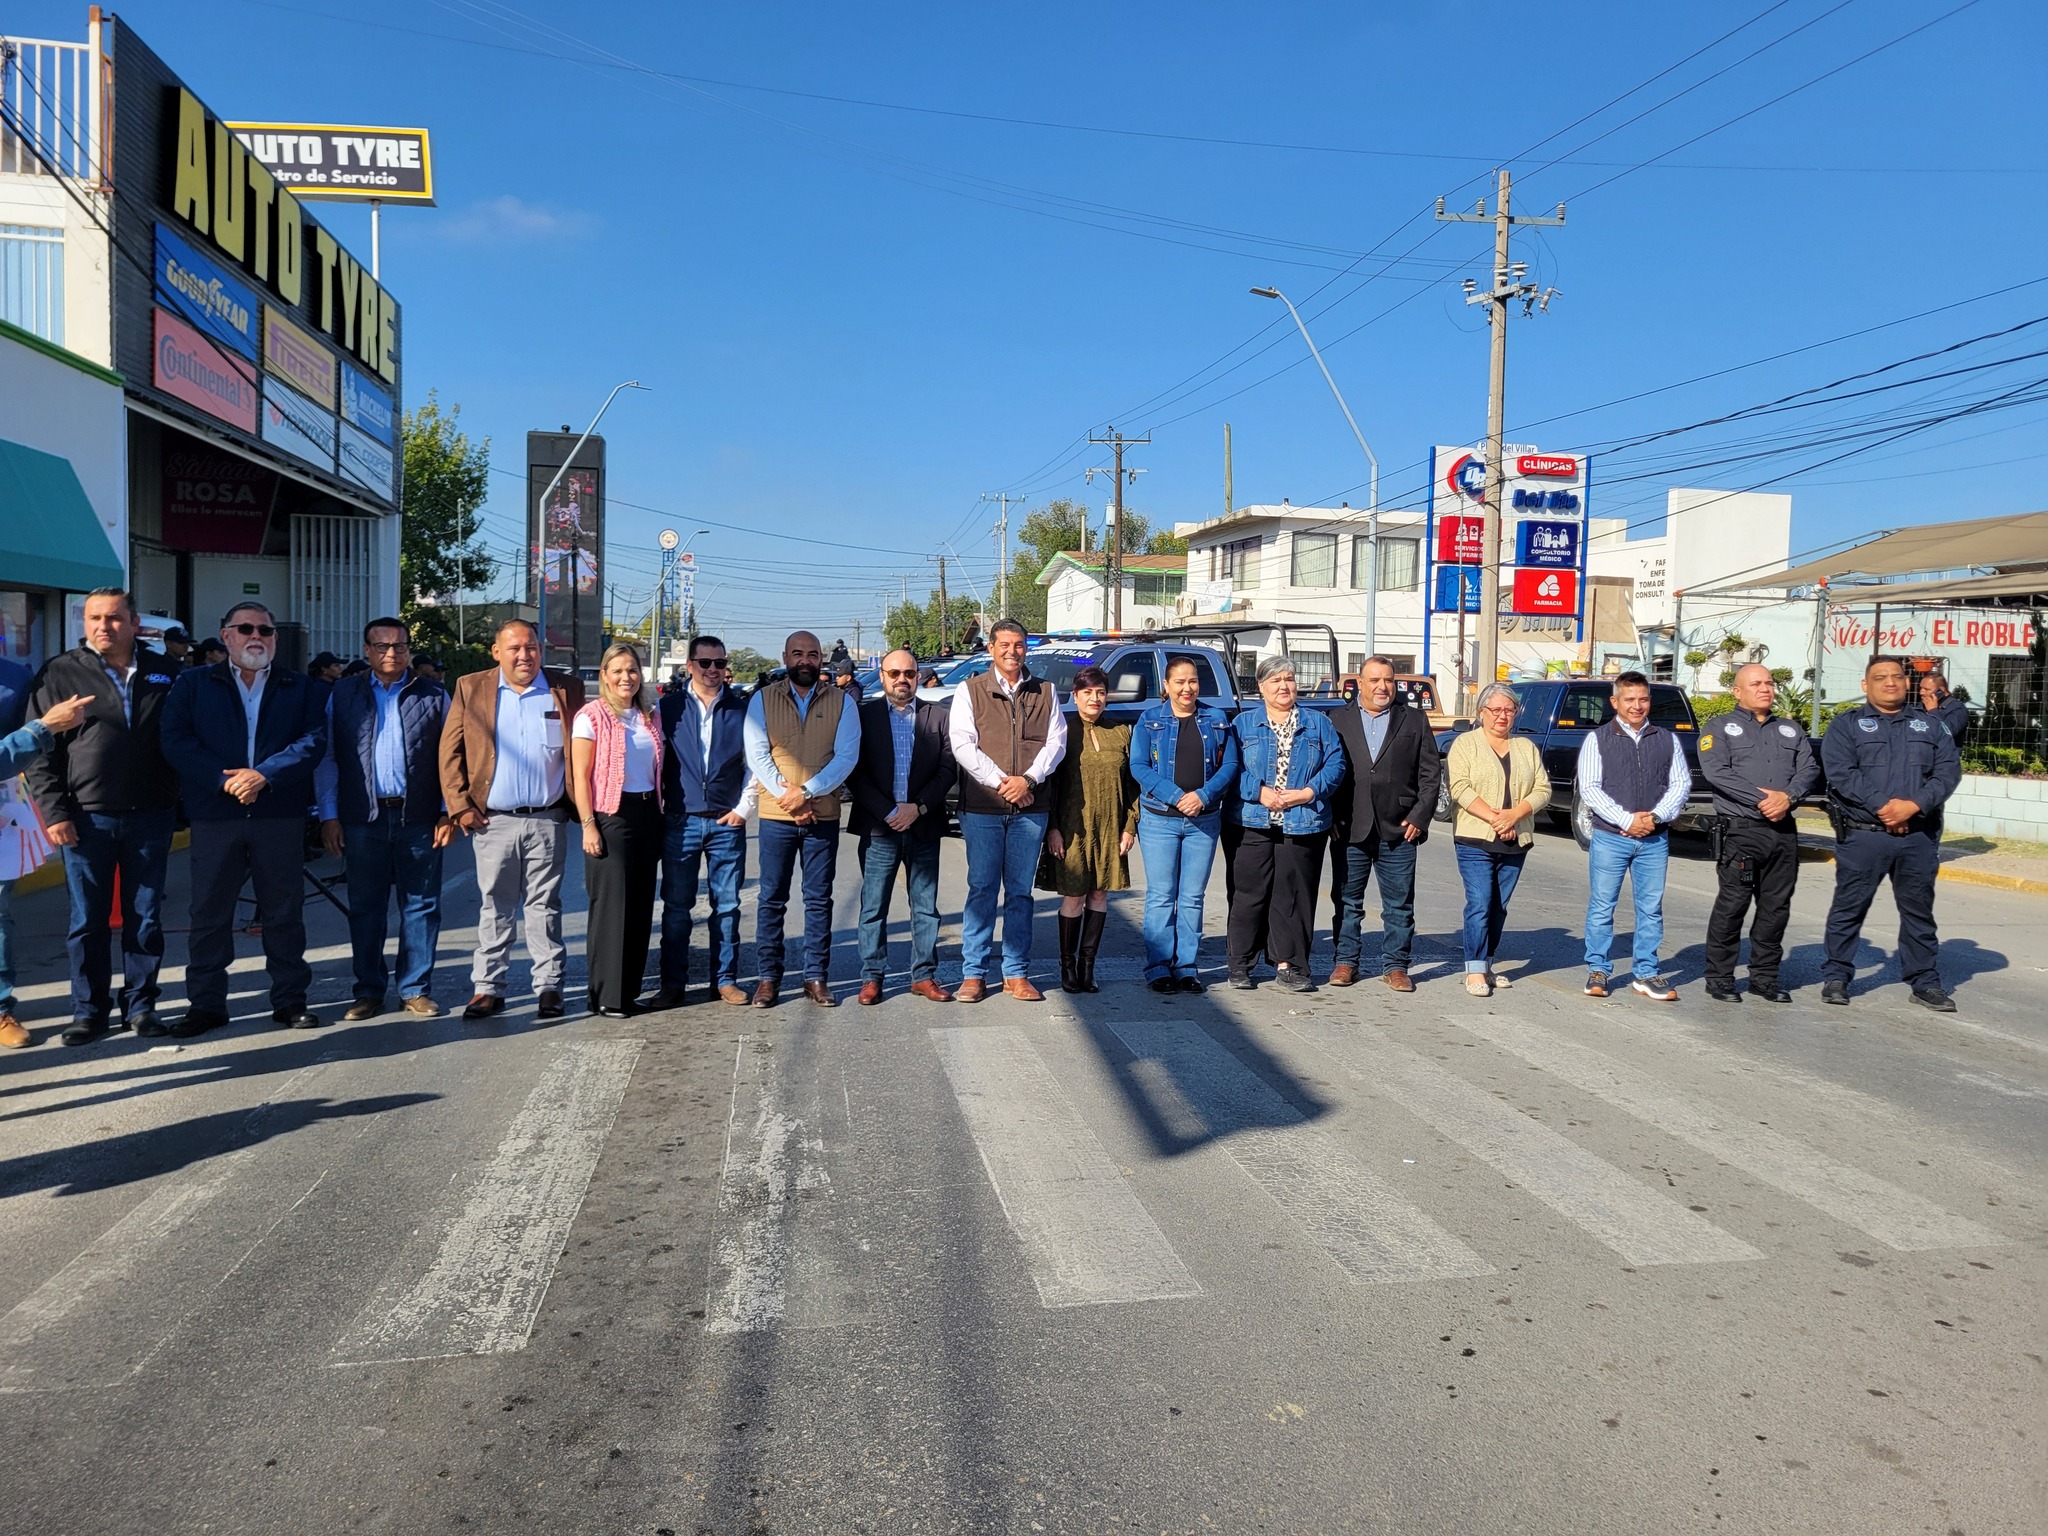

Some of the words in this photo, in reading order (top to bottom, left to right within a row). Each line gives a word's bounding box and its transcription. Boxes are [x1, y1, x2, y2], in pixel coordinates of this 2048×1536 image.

[331, 137, 420, 169] TYRE
[305, 168, 327, 183] de
[331, 169, 398, 186] Servicio
[174, 87, 302, 307] AUTO
[316, 226, 396, 385] TYRE
[159, 334, 241, 409] Continental
[1523, 459, 1573, 472] CLÍNICAS
[175, 480, 256, 505] ROSA
[200, 504, 212, 514] lo
[1530, 548, 1571, 556] CONSULTORIO
[1639, 581, 1657, 589] TOMA
[1838, 616, 1917, 648] Vivero
[1933, 619, 1960, 646] EL
[1966, 621, 2037, 648] ROBLE
